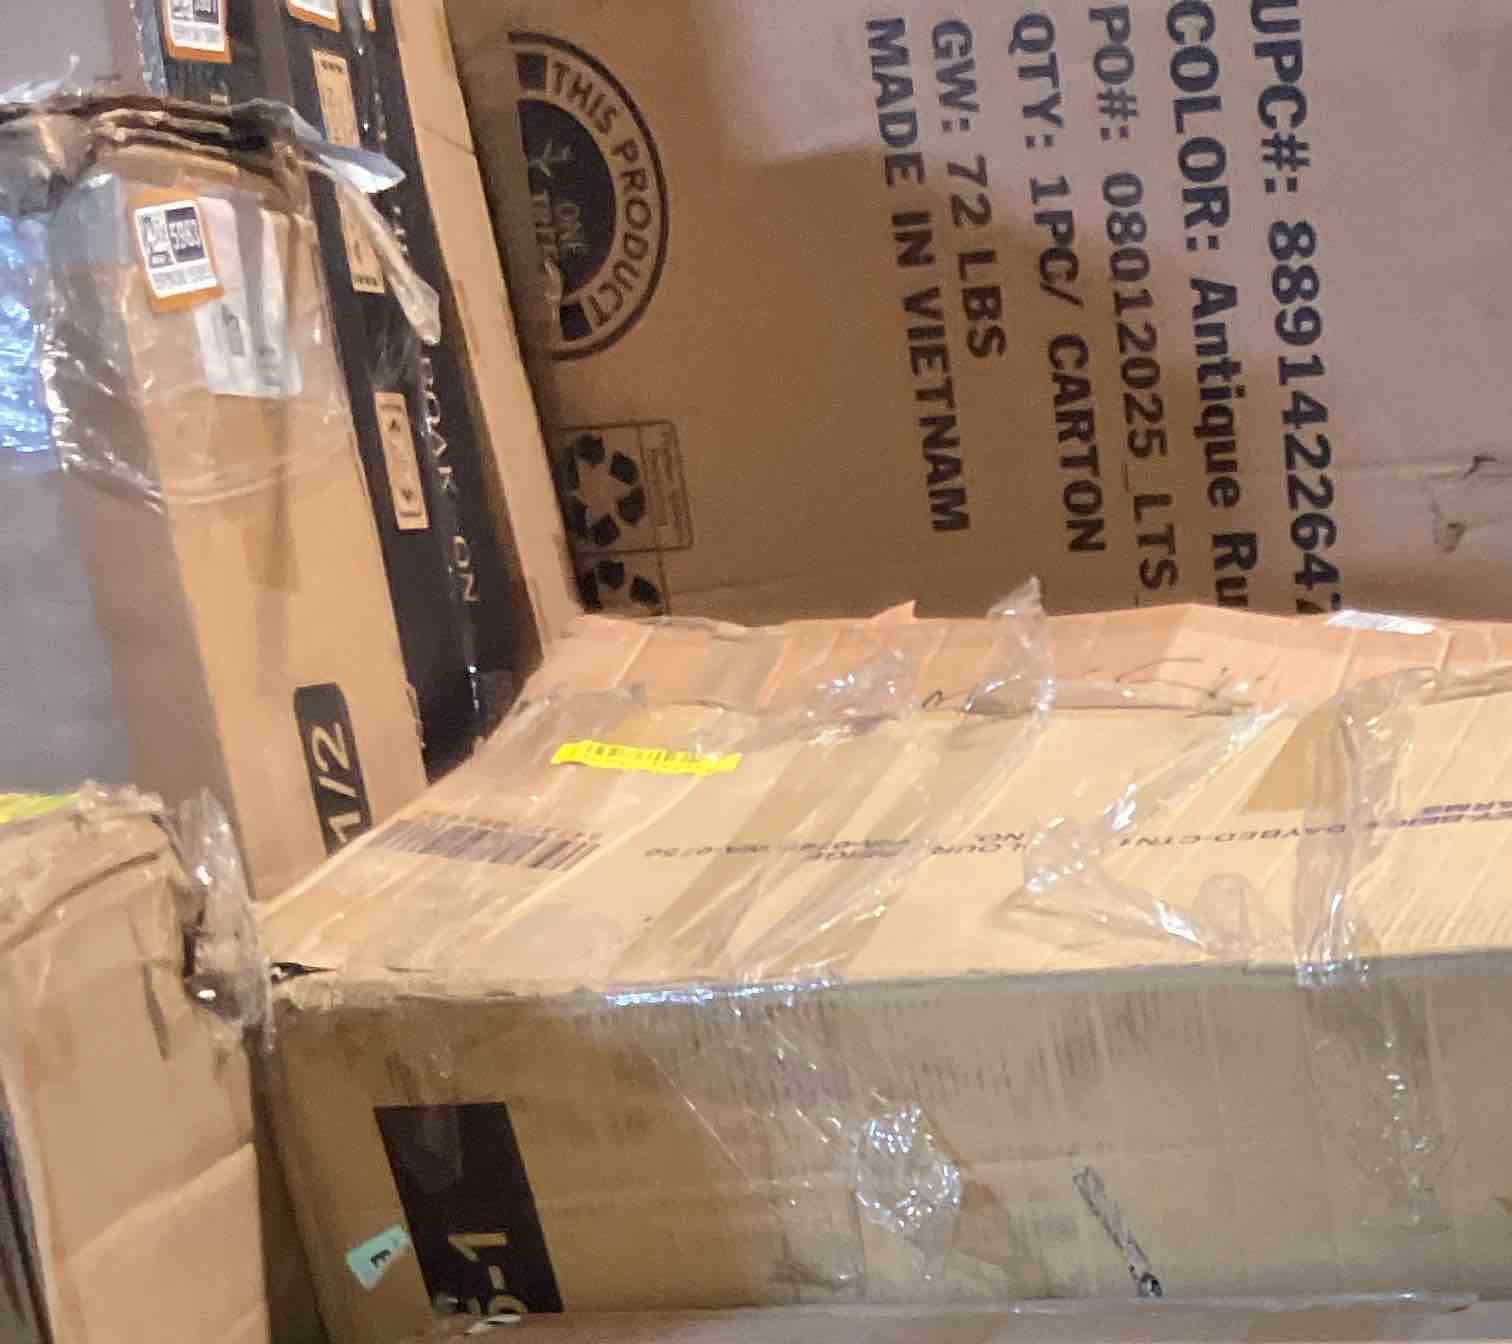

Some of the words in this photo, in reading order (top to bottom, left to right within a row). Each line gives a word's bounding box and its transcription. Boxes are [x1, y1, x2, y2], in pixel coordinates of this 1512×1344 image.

[864, 16, 925, 188] MADE
[931, 18, 978, 135] GW:
[1009, 12, 1064, 150] QTY:
[1088, 5, 1140, 143] PO#:
[1163, 0, 1232, 254] COLOR:
[1249, 0, 1311, 195] UPC#:
[550, 60, 618, 136] THIS
[587, 138, 653, 326] PRODUCT
[890, 210, 935, 269] IN
[945, 153, 993, 228] 72
[1029, 175, 1083, 309] 1PC/
[957, 249, 1007, 361] LBS
[903, 287, 970, 535] VIETNAM
[1047, 333, 1107, 556] CARTON
[1187, 275, 1241, 509] Antique
